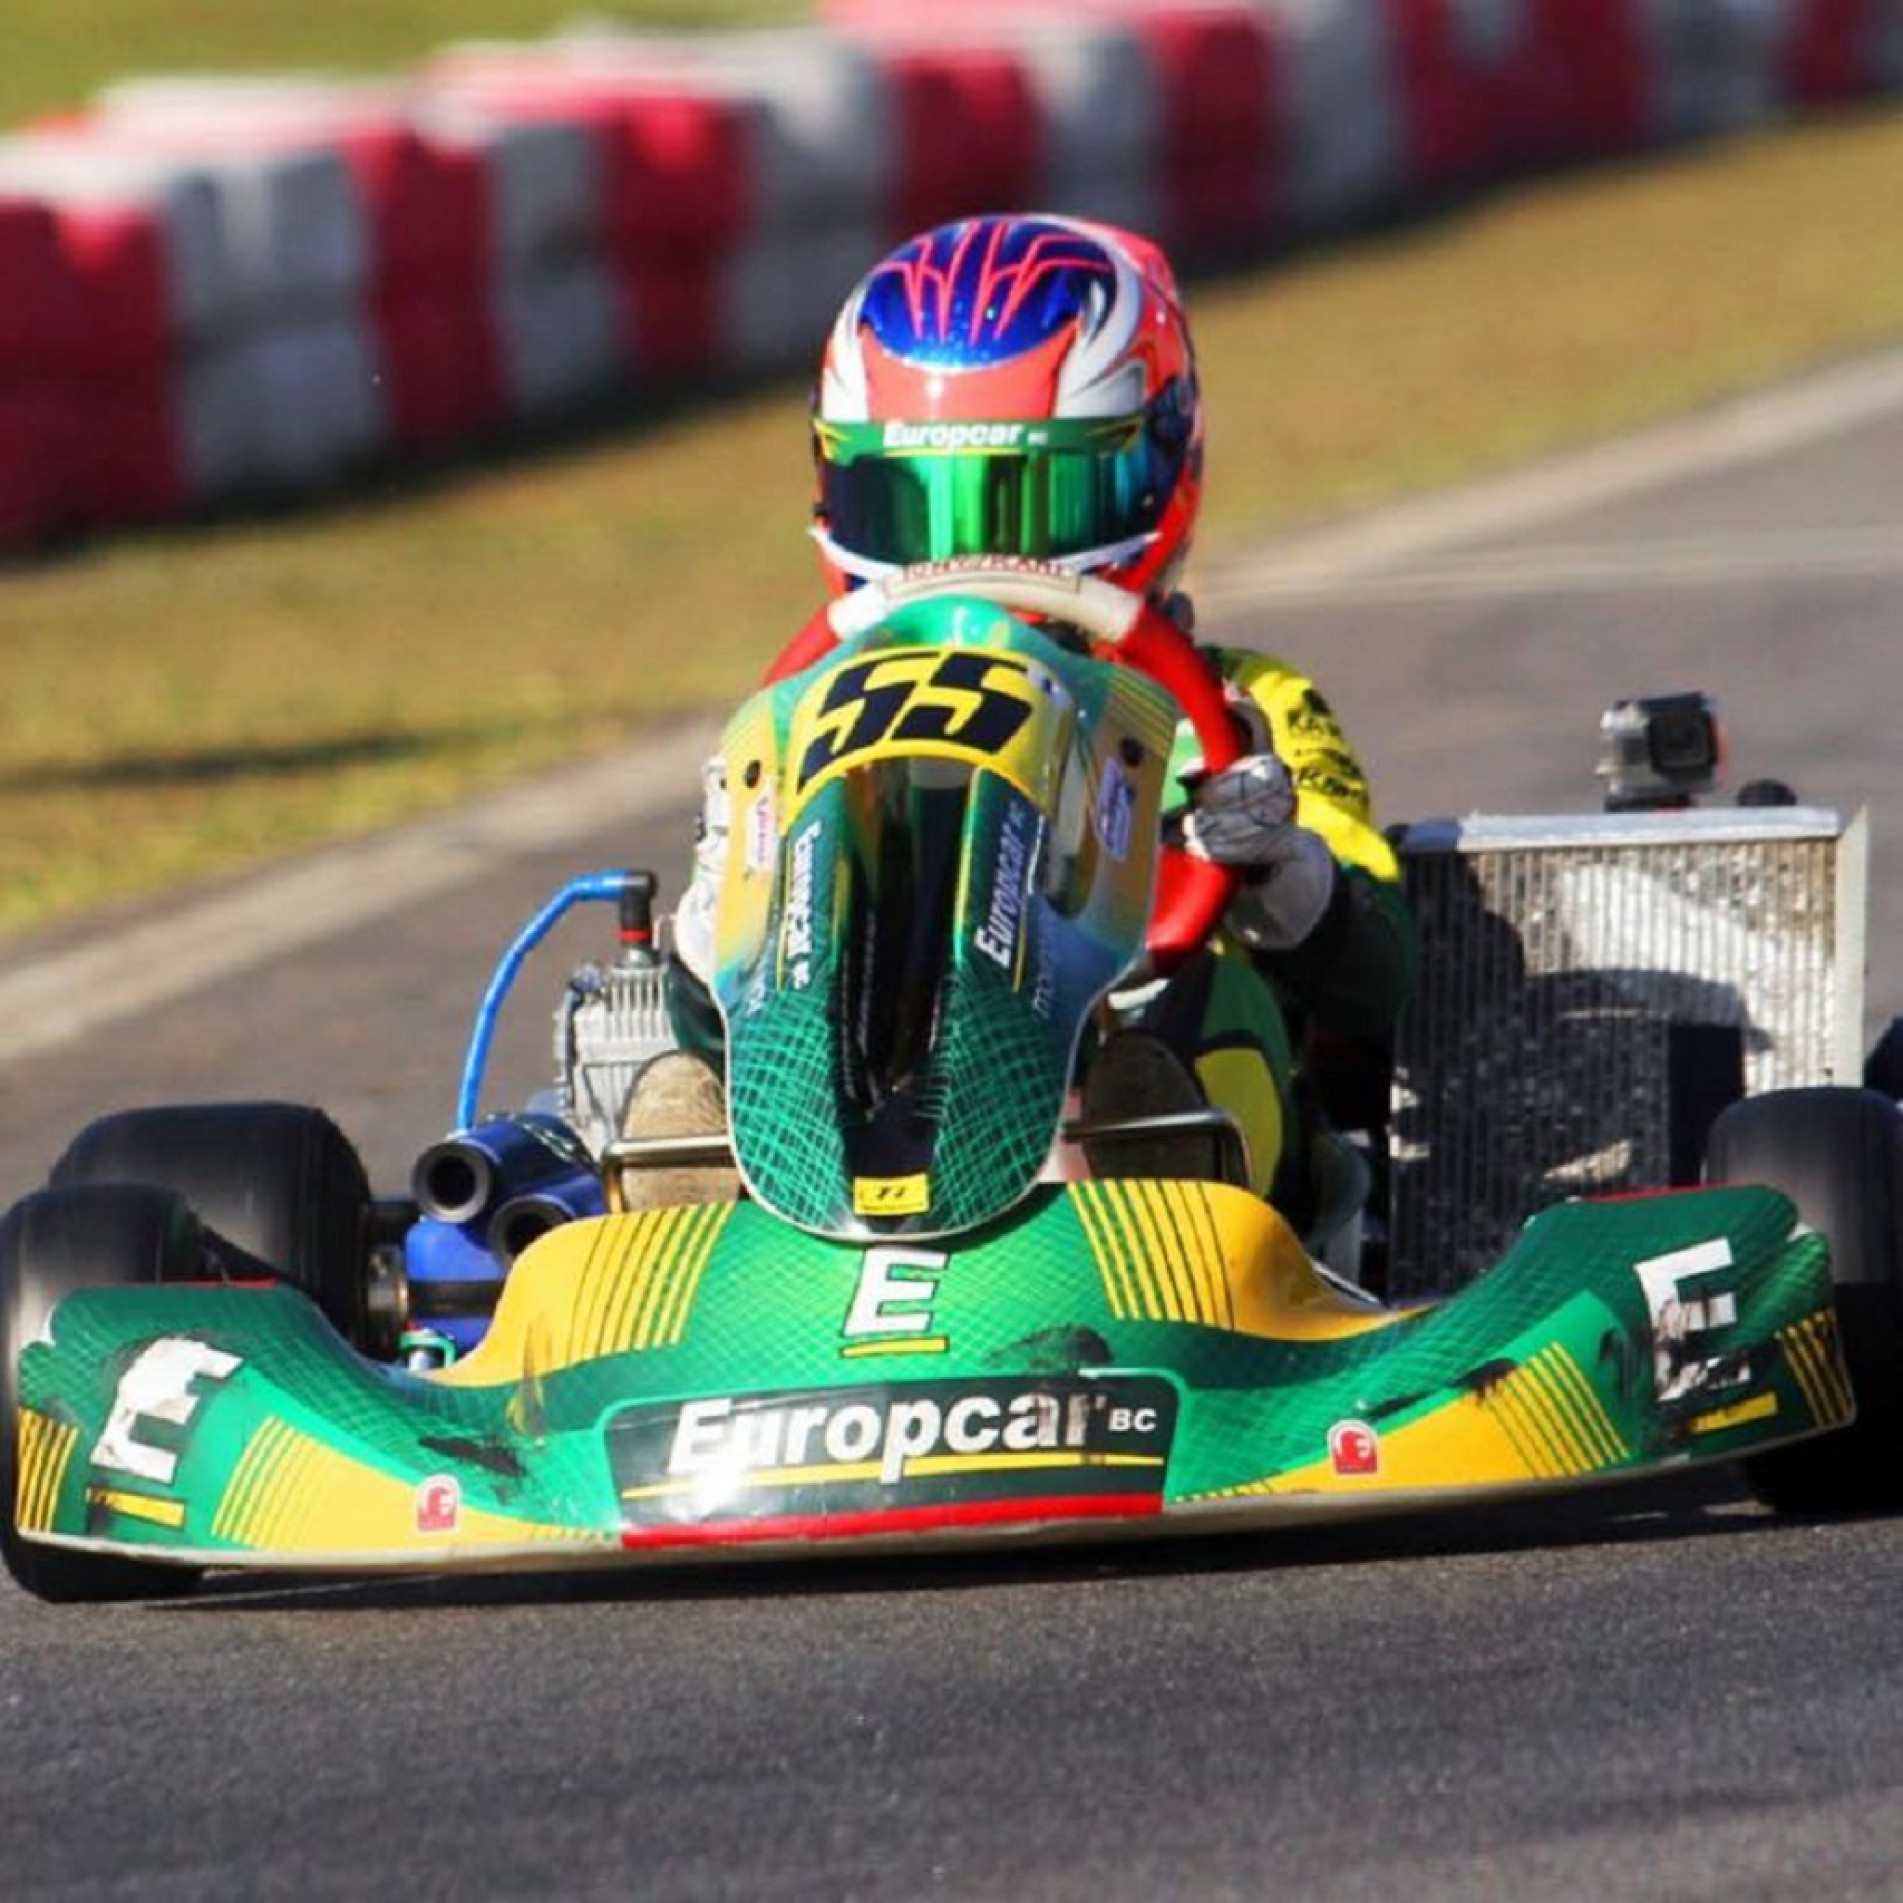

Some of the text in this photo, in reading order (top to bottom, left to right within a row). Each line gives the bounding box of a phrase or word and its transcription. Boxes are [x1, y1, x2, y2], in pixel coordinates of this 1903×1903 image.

[882, 419, 1026, 456] Europcar
[797, 651, 1032, 795] 55
[843, 1246, 949, 1339] E
[667, 1390, 1157, 1483] Europcar BC
